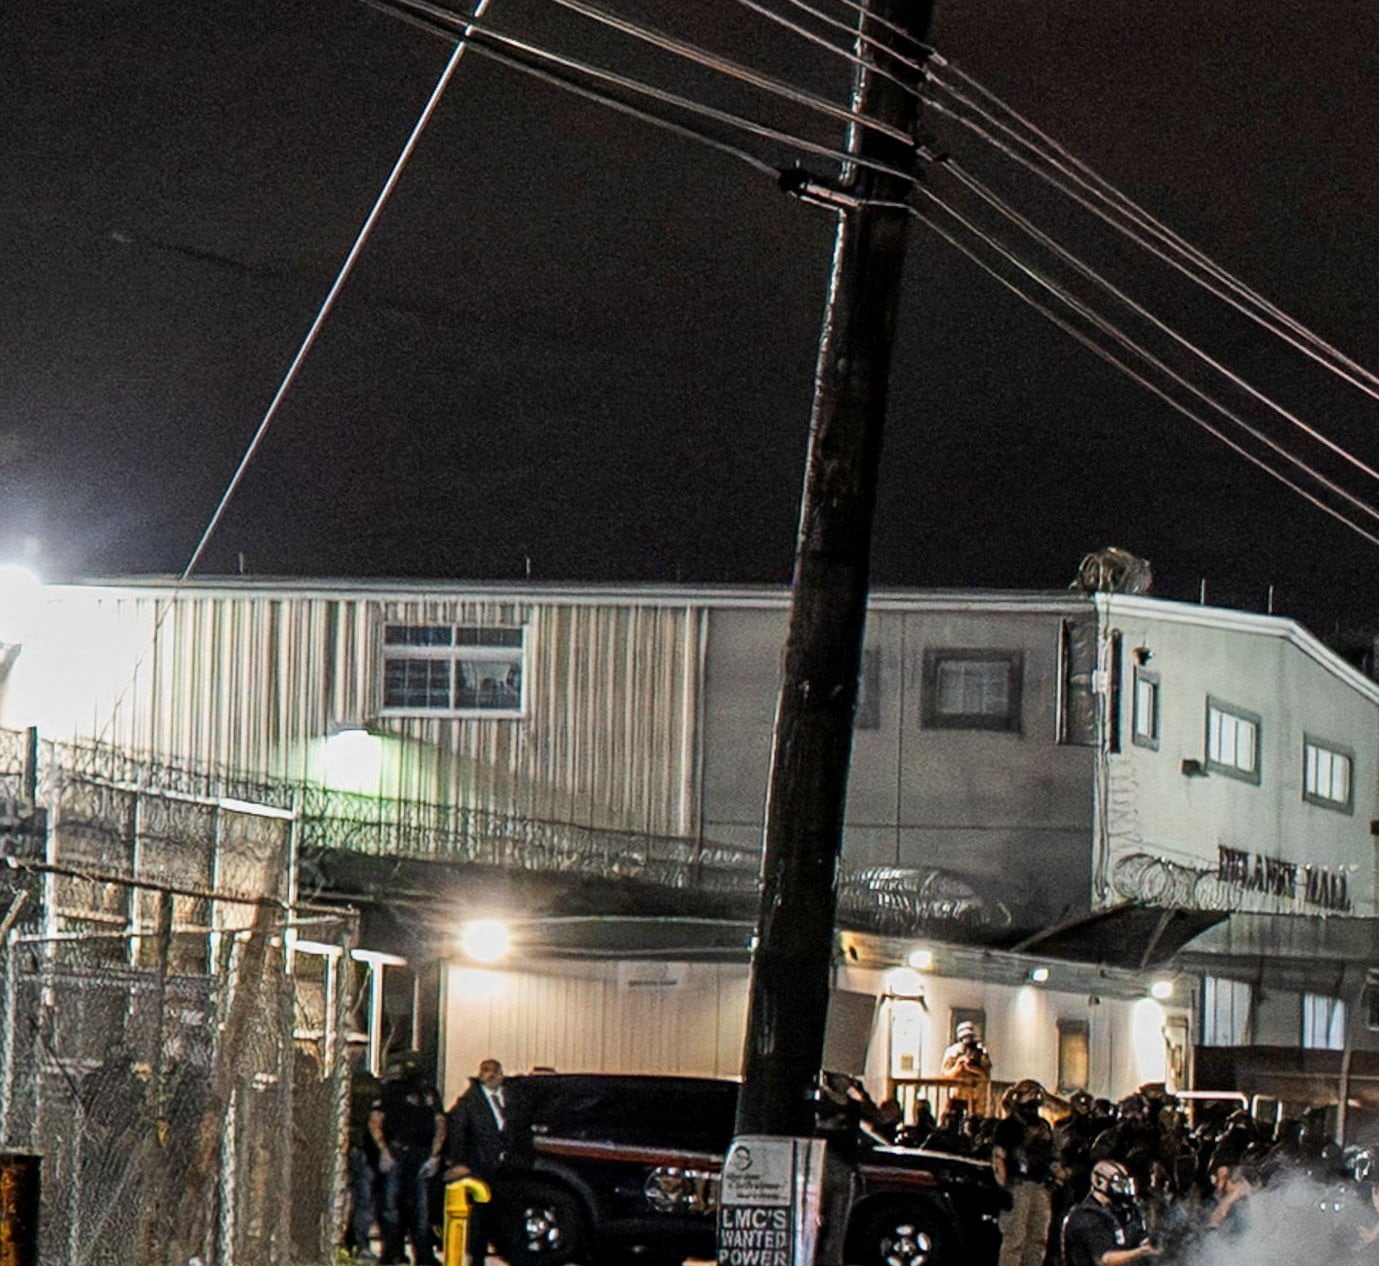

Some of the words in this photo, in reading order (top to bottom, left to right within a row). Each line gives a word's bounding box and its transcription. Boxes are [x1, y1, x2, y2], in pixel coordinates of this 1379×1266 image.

[722, 1208, 786, 1229] LMC'S
[721, 1229, 786, 1248] WANTED
[719, 1248, 787, 1266] POWER
